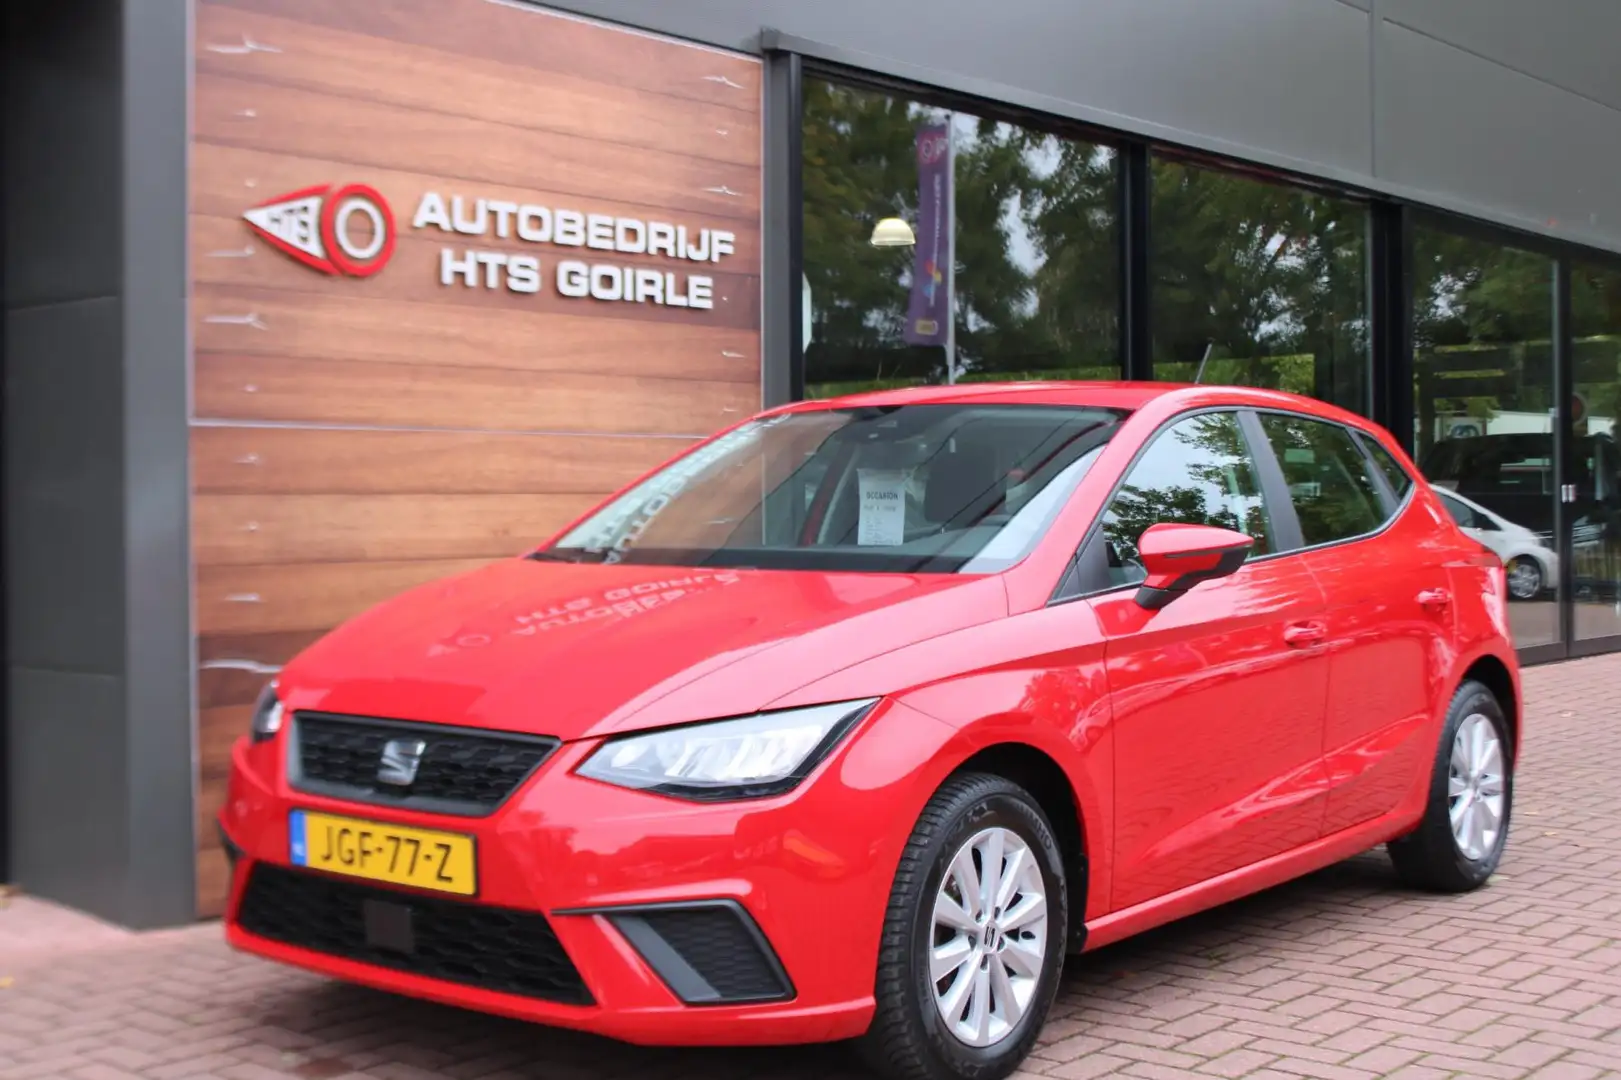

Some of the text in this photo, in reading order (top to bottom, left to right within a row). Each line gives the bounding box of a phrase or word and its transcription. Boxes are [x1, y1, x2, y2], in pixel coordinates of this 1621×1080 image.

[412, 191, 735, 262] AUTOBEDRIJF
[440, 248, 714, 310] HTS GOIRLE
[321, 826, 453, 883] JGF-77-Z
